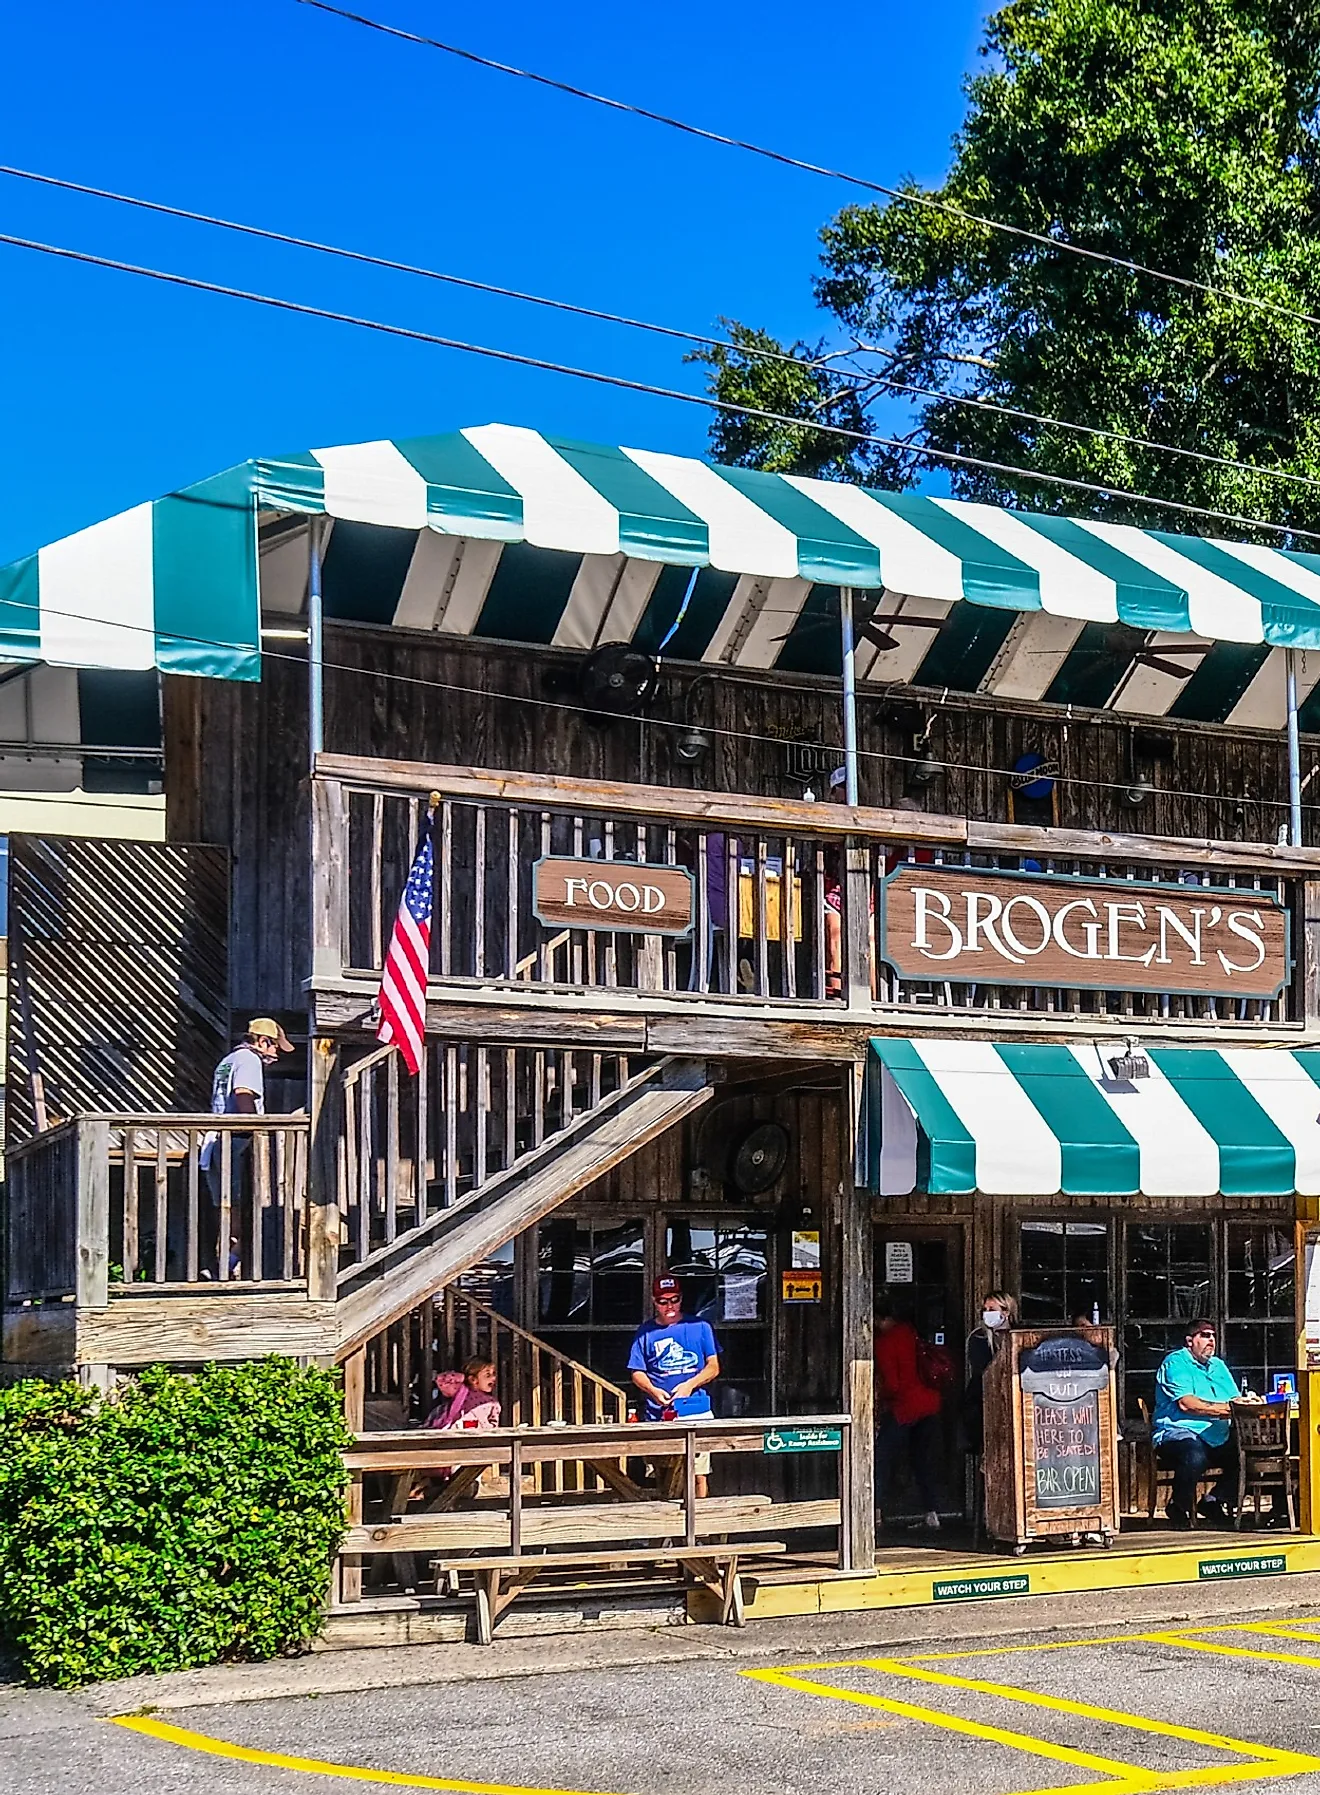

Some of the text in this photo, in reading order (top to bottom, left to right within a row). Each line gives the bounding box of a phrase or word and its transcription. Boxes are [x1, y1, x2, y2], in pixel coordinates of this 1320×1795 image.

[563, 877, 666, 913] FOOD
[910, 886, 1265, 976] BROGEN'S
[1035, 1405, 1094, 1426] PLEASE WAIT
[1036, 1428, 1084, 1445] HERE TO
[1036, 1443, 1097, 1461] BE SEATED!
[1036, 1464, 1096, 1495] BAR OPEN
[1201, 1558, 1283, 1575] WATCH YOUR STEP
[937, 1579, 1027, 1596] WATCH YOUR STEP
